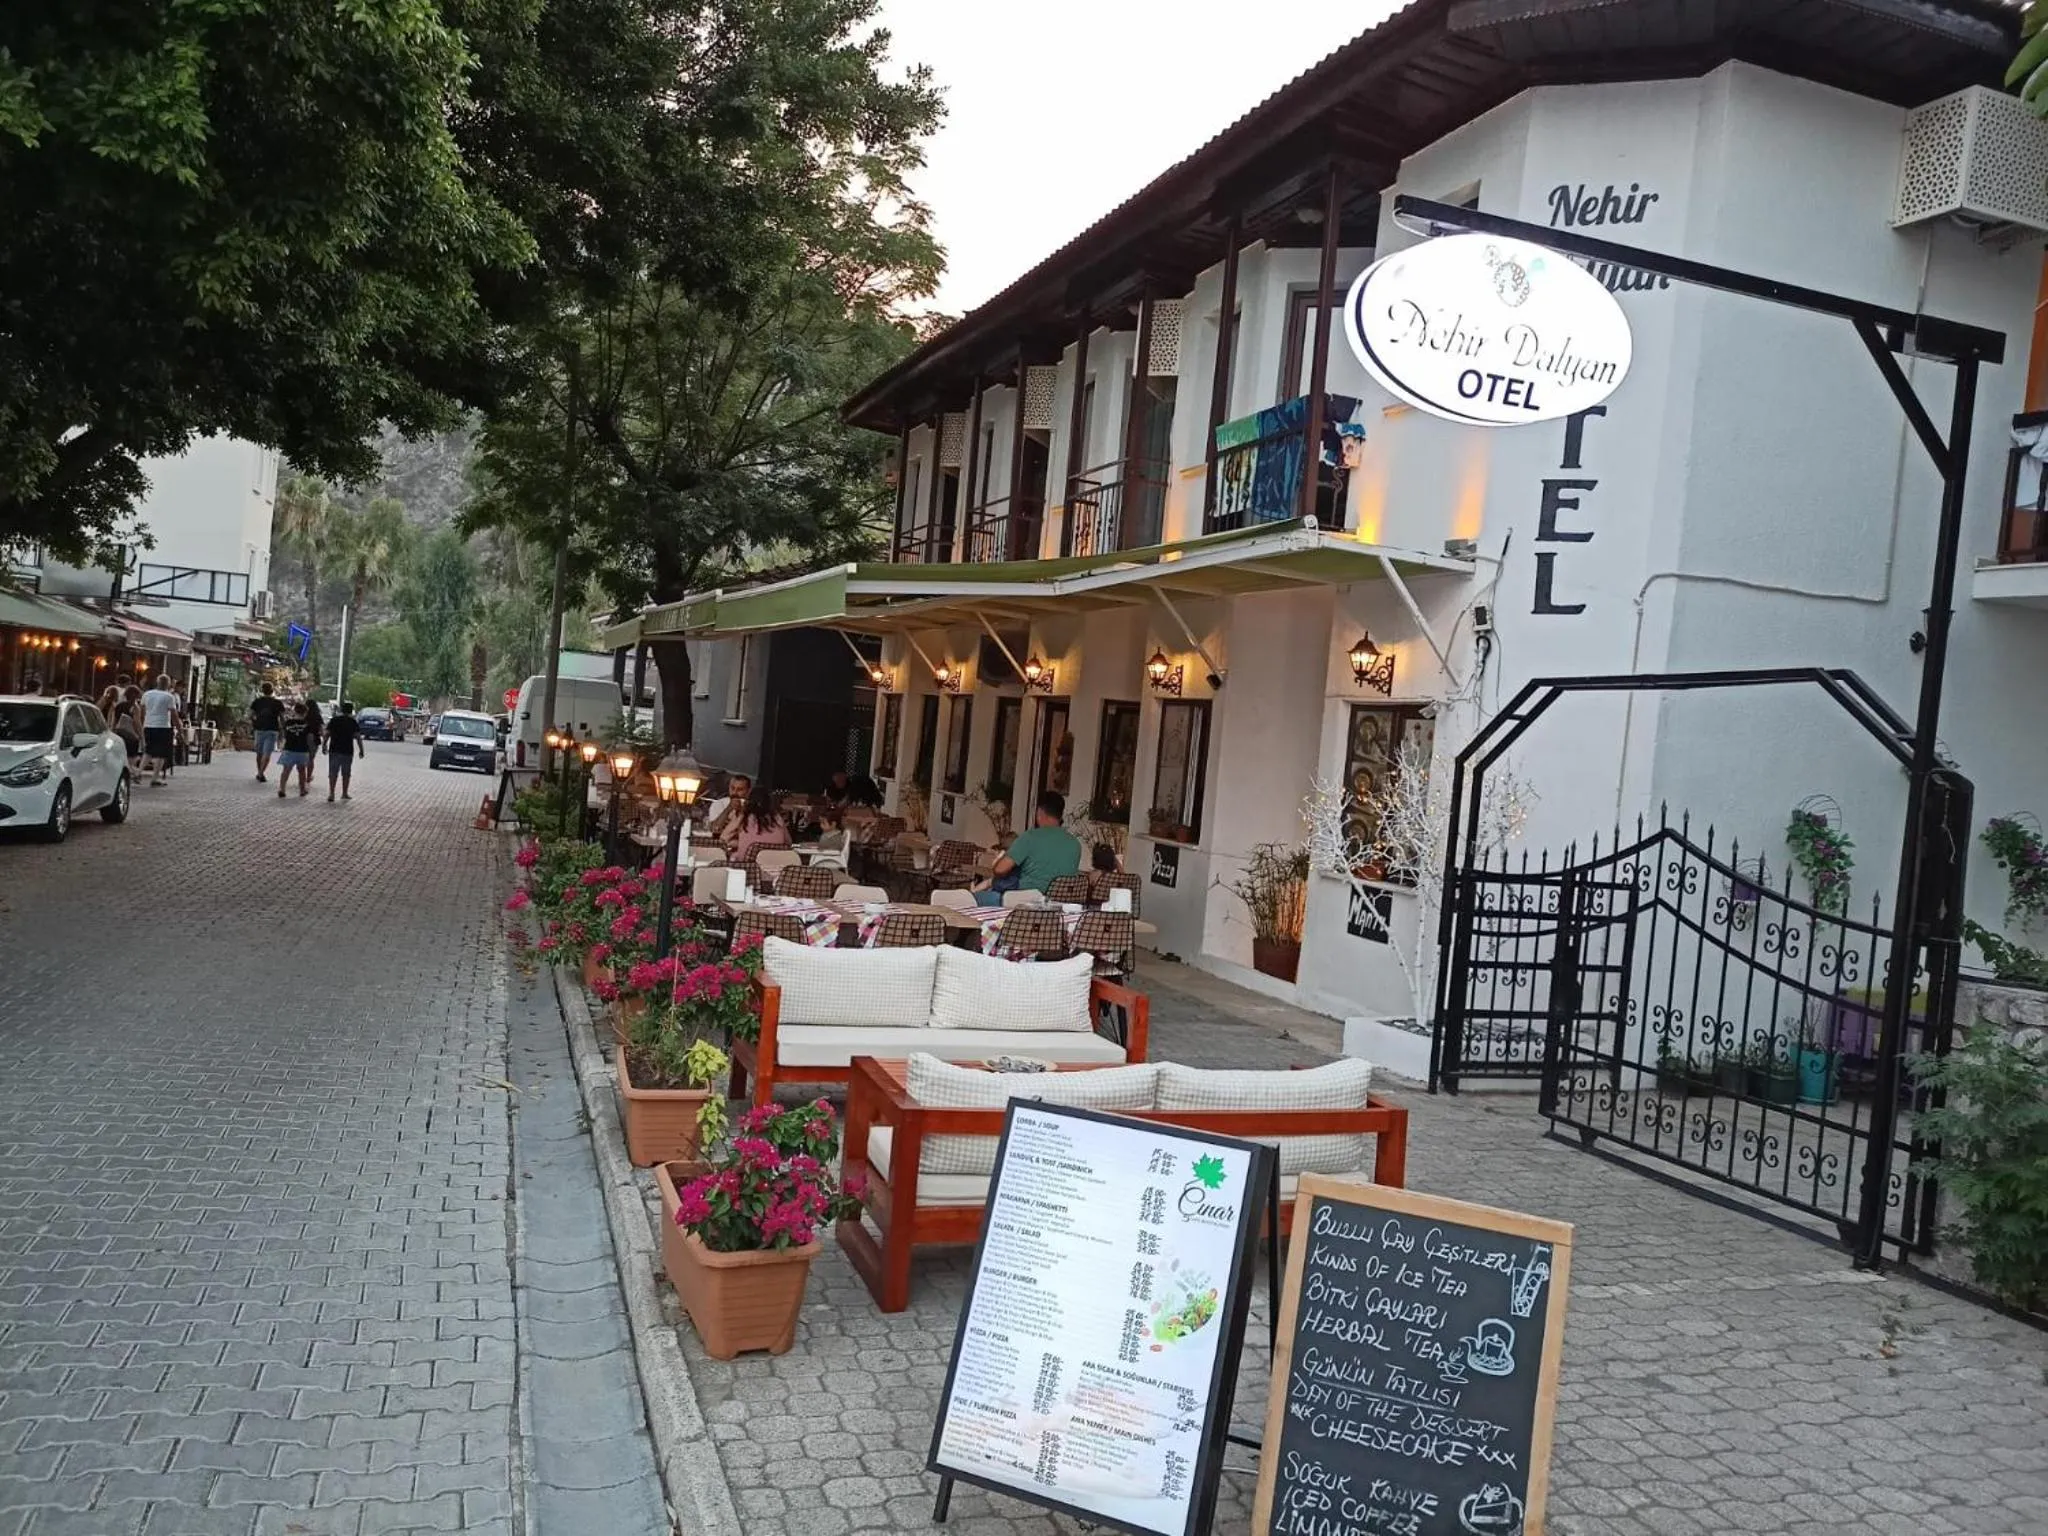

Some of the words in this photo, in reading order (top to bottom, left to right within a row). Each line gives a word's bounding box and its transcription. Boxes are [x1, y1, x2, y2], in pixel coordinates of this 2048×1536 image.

[1548, 183, 1659, 226] Nehir
[1388, 299, 1485, 358] Nehir
[1504, 324, 1617, 387] Dalyan
[1457, 369, 1541, 411] OTEL
[1381, 1219, 1415, 1253] ÇAY
[1310, 1242, 1357, 1272] KINDS
[1366, 1256, 1389, 1279] OF
[1395, 1263, 1425, 1288] ICE
[1431, 1266, 1468, 1297] TEA
[1301, 1308, 1391, 1351] HERBAL
[1405, 1328, 1443, 1360] TEA
[1365, 1287, 1448, 1329] ÇAYLARI
[1303, 1347, 1375, 1386] GÜNÜN
[1385, 1363, 1461, 1407] TATLISI
[1292, 1372, 1332, 1405] DAY
[1336, 1391, 1360, 1411] OF
[1366, 1396, 1405, 1423] THE
[1411, 1407, 1510, 1441] DESSERT
[1311, 1414, 1473, 1466] CHEESECAKE
[1284, 1451, 1351, 1494] SOĞUK
[1369, 1479, 1439, 1516] KAHVE
[1283, 1485, 1332, 1510] ICED
[1341, 1497, 1422, 1536] COFFEE
